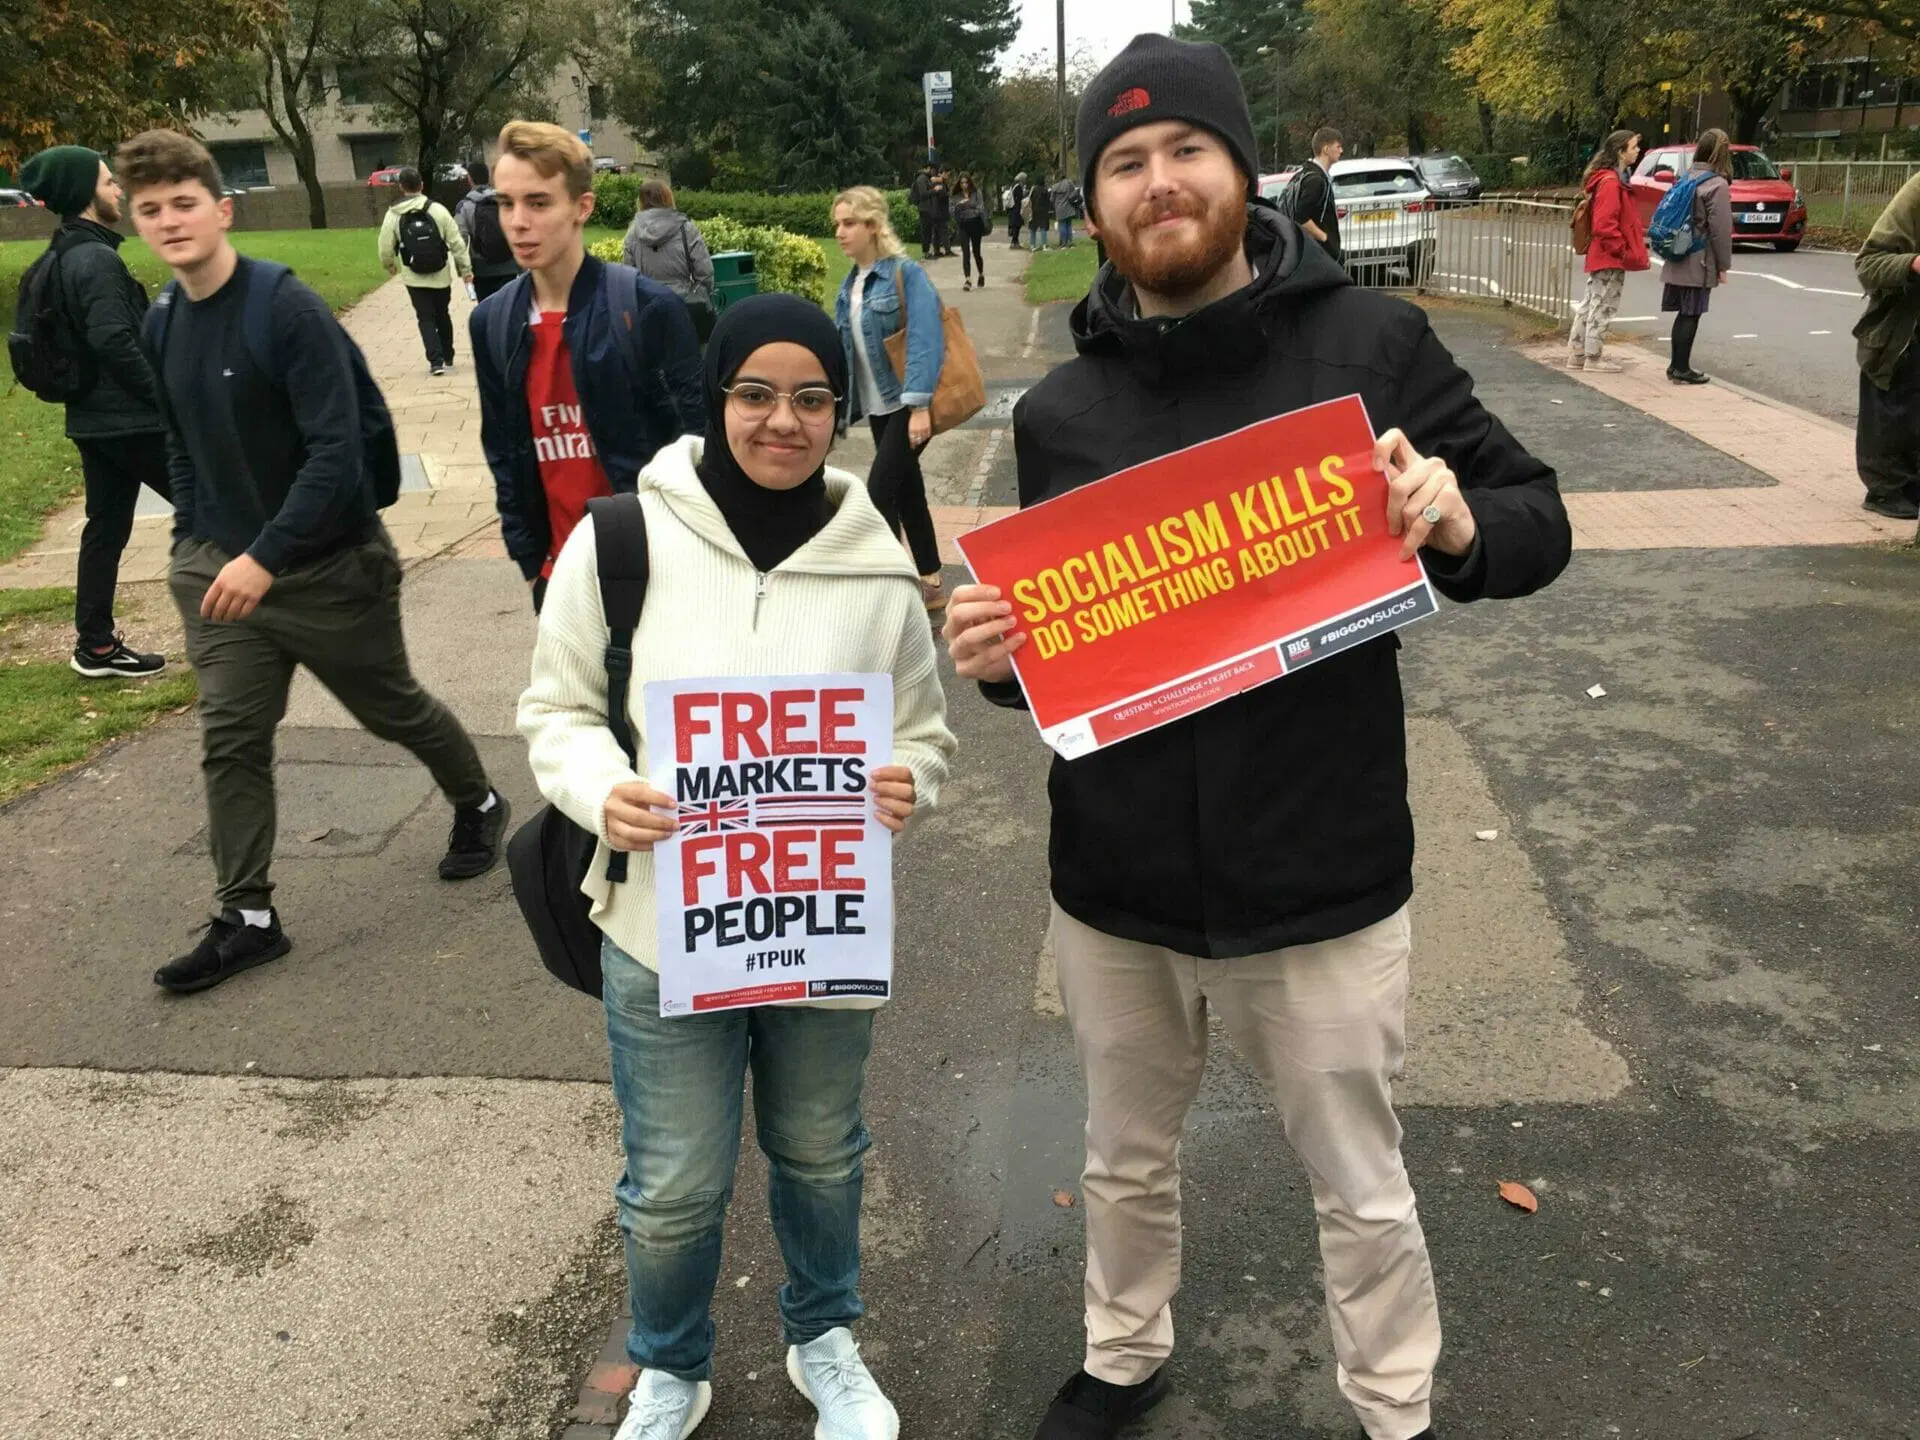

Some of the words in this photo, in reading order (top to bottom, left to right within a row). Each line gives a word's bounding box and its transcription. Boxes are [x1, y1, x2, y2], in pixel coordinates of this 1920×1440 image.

[541, 403, 581, 428] Fly
[1013, 500, 1231, 623] SOCIALISM
[1229, 455, 1354, 541] KILLS
[1032, 619, 1074, 660] DO
[1073, 557, 1235, 644] SOMETHING
[1238, 518, 1330, 580] ABOUT
[1334, 505, 1363, 542] IT
[1287, 637, 1310, 654] BIG
[1320, 597, 1417, 646] #BIGGOVSUCKS
[1113, 700, 1154, 721] QUESTION
[1157, 681, 1204, 705] CHALLENGE
[1208, 670, 1232, 686] FIGHT
[1233, 662, 1255, 676] BACK
[673, 687, 867, 764] FREE
[676, 757, 867, 802] MARKETS
[681, 828, 866, 906] FREE
[684, 893, 866, 953] PEOPLE
[746, 948, 806, 972] #TPUK
[811, 981, 827, 990] BIG
[830, 983, 884, 992] #BIGGOVSUCKS
